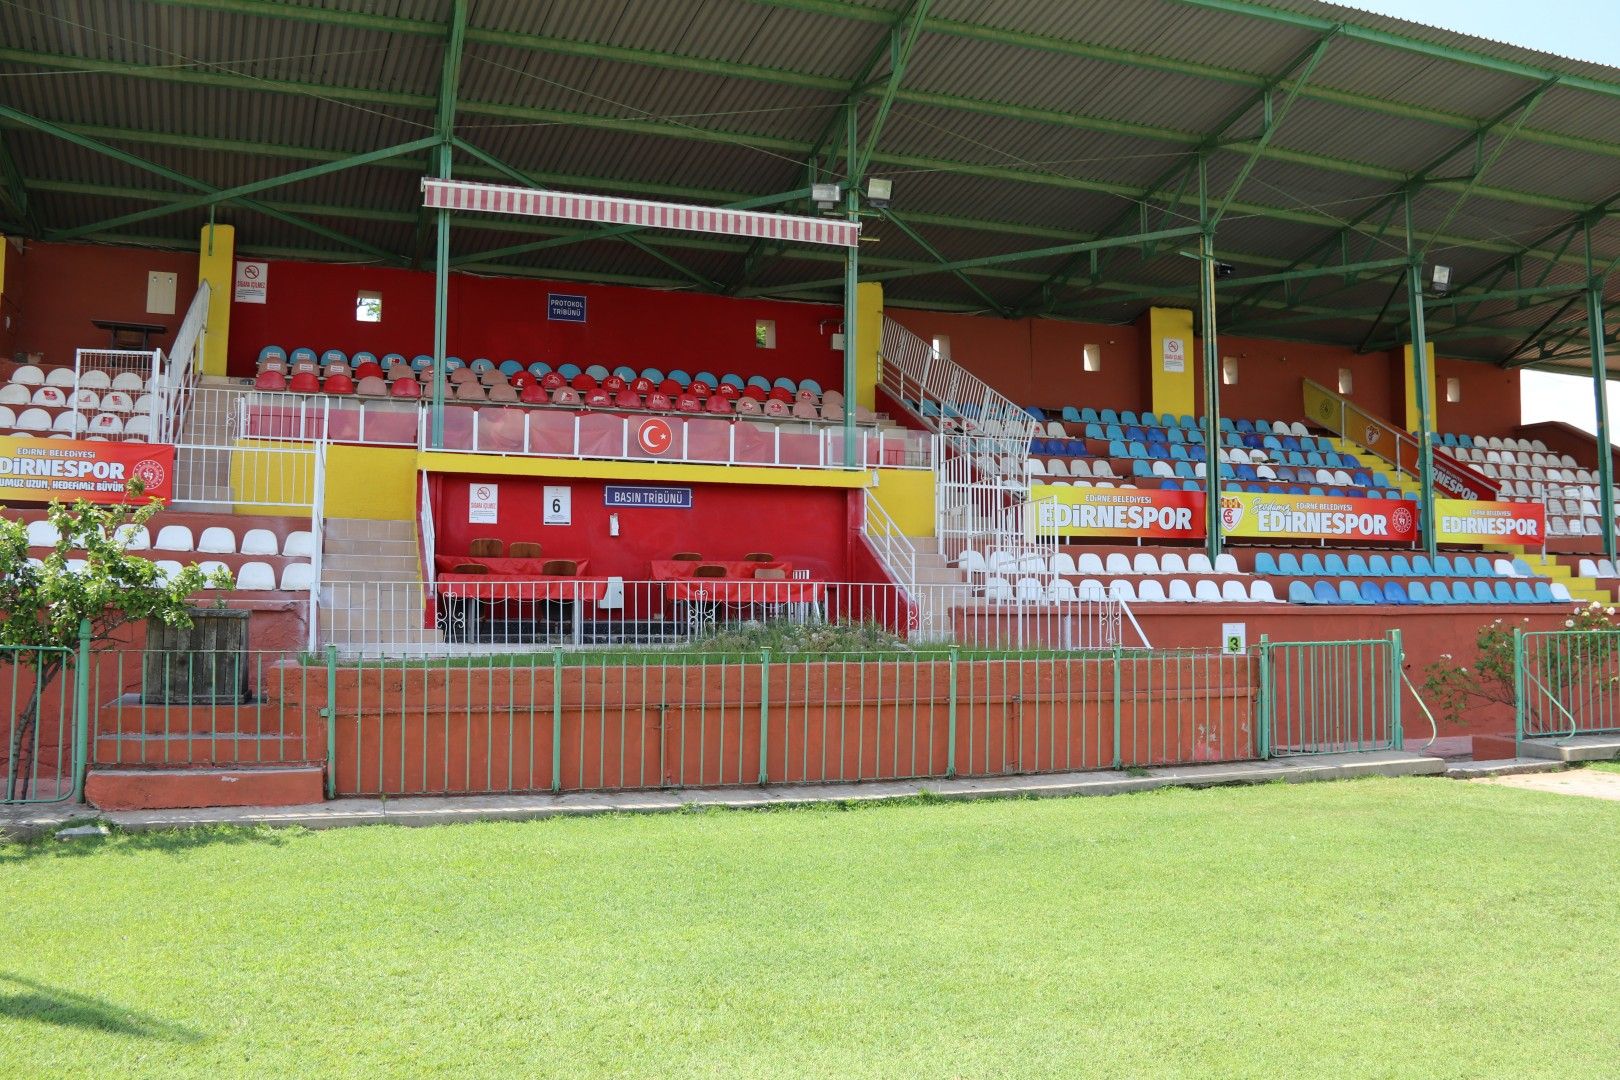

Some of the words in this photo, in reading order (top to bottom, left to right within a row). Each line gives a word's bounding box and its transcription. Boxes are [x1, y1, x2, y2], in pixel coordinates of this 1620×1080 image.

[550, 299, 583, 308] PROTOKOL
[553, 307, 581, 316] TRİBÜNÜ
[0, 478, 24, 489] UMUZ
[96, 481, 124, 493] BÜYÜK
[614, 491, 641, 503] BASIN
[643, 490, 683, 504] TRİBÜNÜ
[552, 498, 561, 513] 6
[1230, 637, 1239, 651] 3
